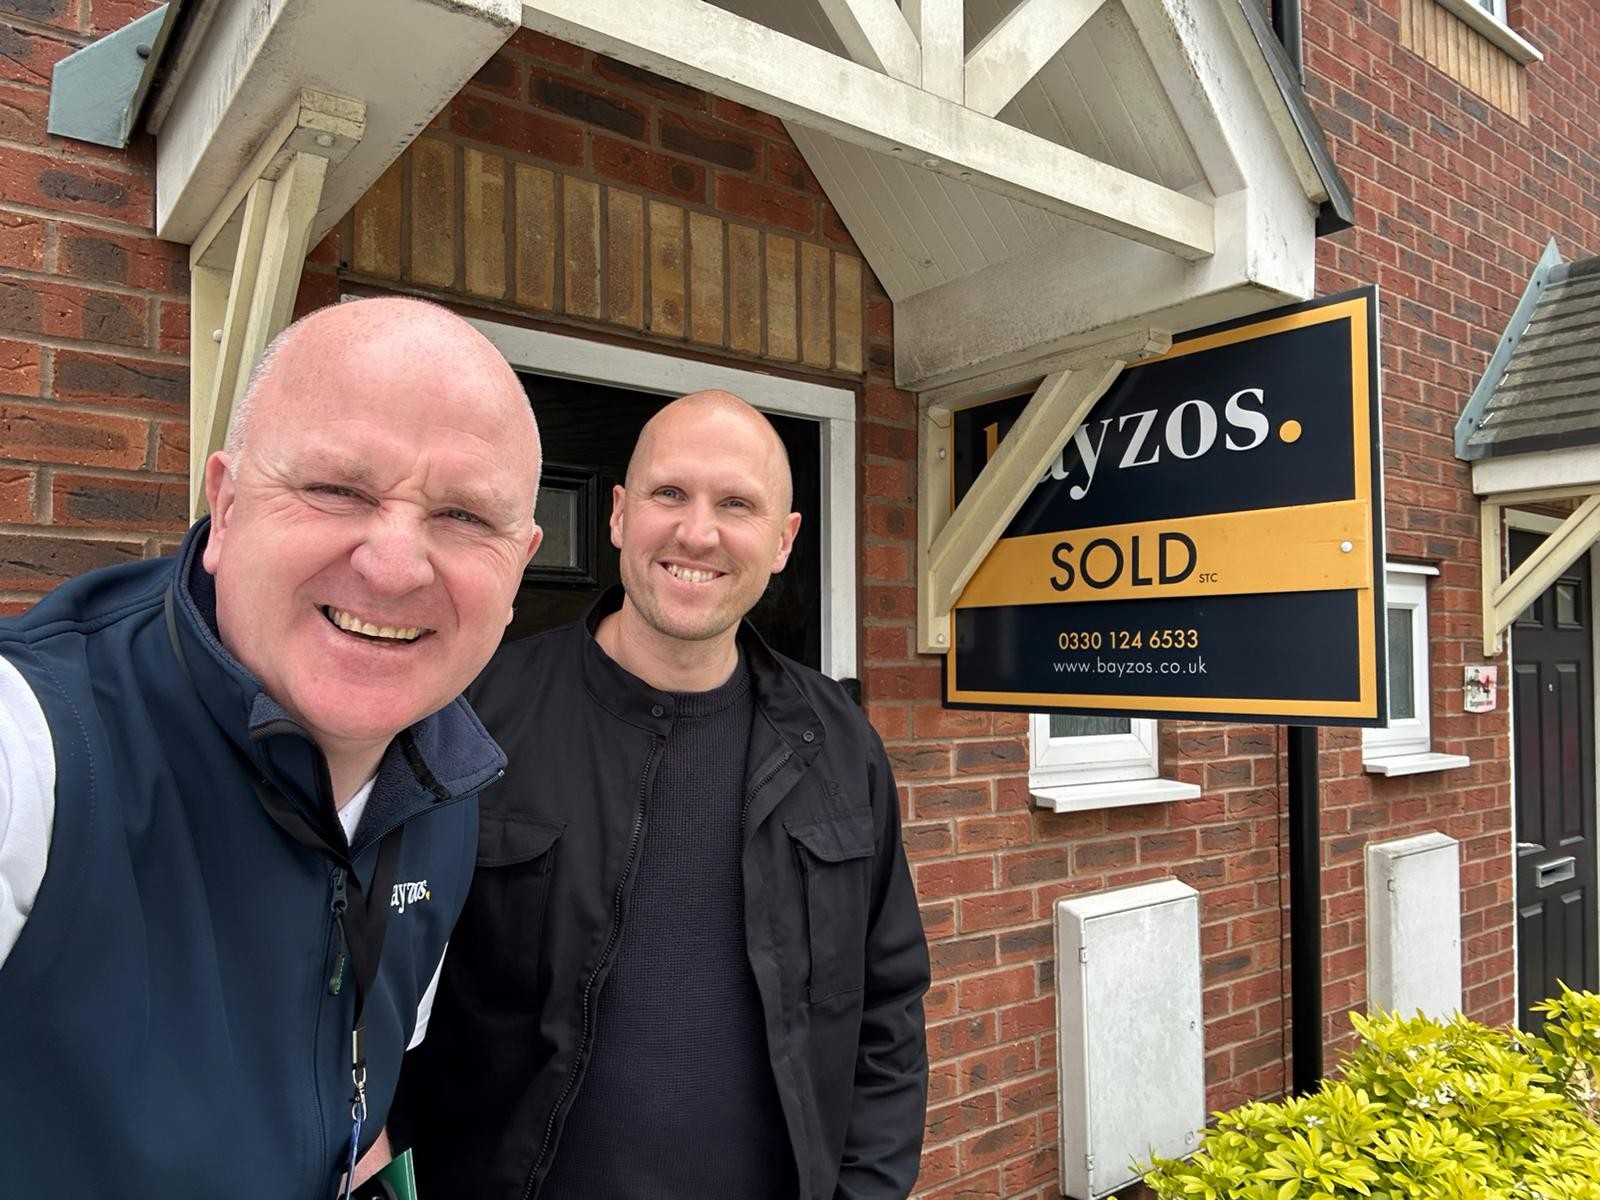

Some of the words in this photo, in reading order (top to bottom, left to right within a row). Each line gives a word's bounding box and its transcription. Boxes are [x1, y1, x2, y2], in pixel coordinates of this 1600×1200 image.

[984, 388, 1302, 500] yzos.
[1050, 532, 1197, 592] SOLD
[1198, 573, 1219, 583] STC
[1058, 632, 1101, 650] 0330
[1109, 630, 1142, 649] 124
[1149, 629, 1199, 649] 6533
[1053, 656, 1207, 678] www.bayzos.co.uk
